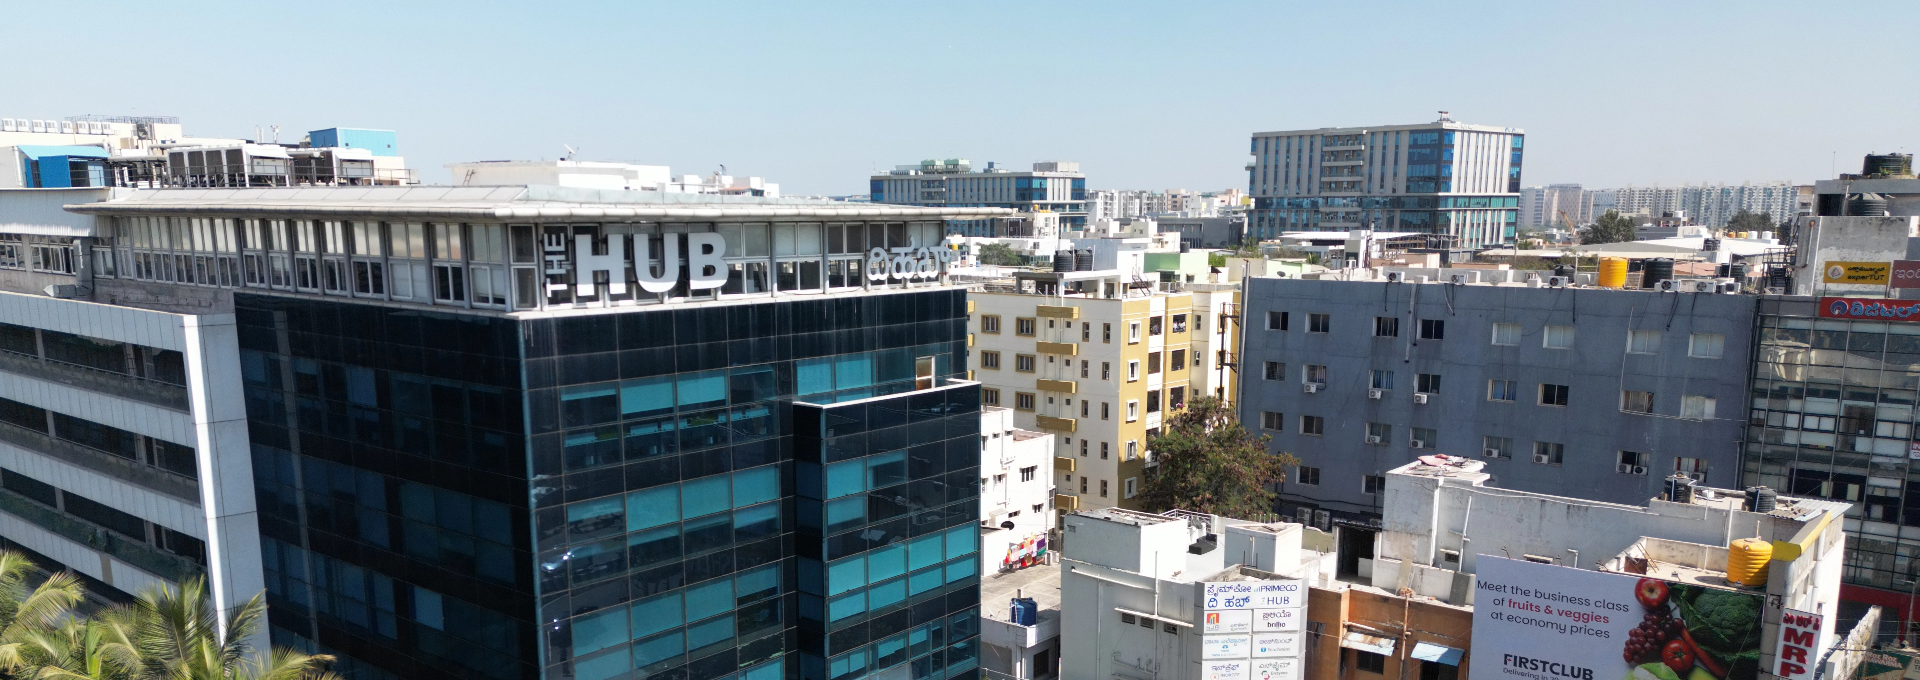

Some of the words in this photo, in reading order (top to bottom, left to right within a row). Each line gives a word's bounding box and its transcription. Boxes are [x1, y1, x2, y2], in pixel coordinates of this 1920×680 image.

[546, 233, 567, 298] THE
[575, 231, 730, 297] HUB
[1267, 596, 1290, 605] HUB
[1477, 580, 1507, 594] Meet
[1511, 585, 1531, 597] the
[1534, 589, 1591, 607] business
[1594, 599, 1629, 613] class
[1493, 597, 1505, 606] of
[1508, 598, 1541, 612] fruits
[1544, 605, 1553, 615] &
[1557, 608, 1609, 624] veggies
[1491, 611, 1503, 621] at
[1507, 614, 1567, 634] economy
[1570, 624, 1610, 639] prices
[1503, 653, 1594, 680] FIRSTCLUB
[1779, 627, 1815, 678] MRP
[1503, 667, 1539, 680] Delivering
